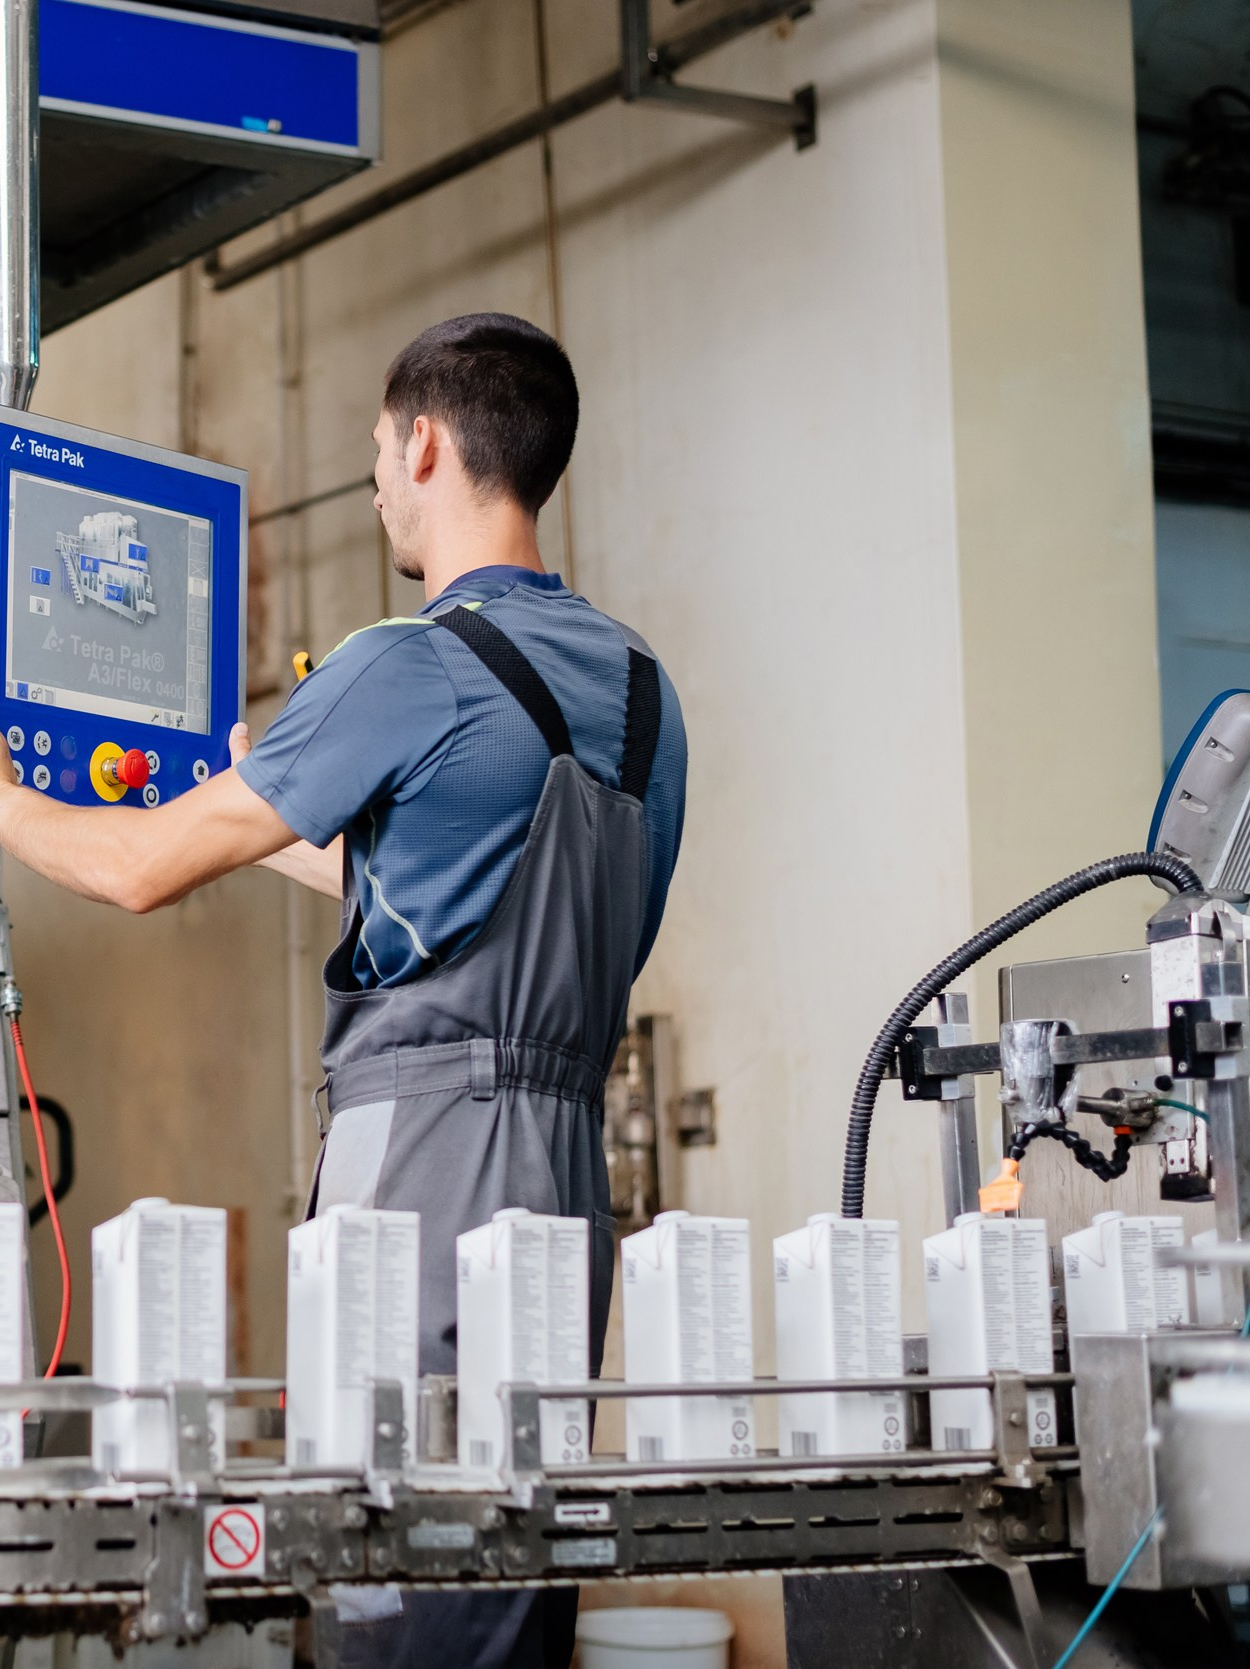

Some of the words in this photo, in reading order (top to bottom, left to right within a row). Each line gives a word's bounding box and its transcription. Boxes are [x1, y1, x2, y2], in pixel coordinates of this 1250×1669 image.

[28, 439, 59, 462] Tetra
[62, 447, 85, 468] Pak
[70, 634, 114, 662] Tetra
[88, 662, 152, 694] A3/Flex
[156, 681, 185, 700] 0400
